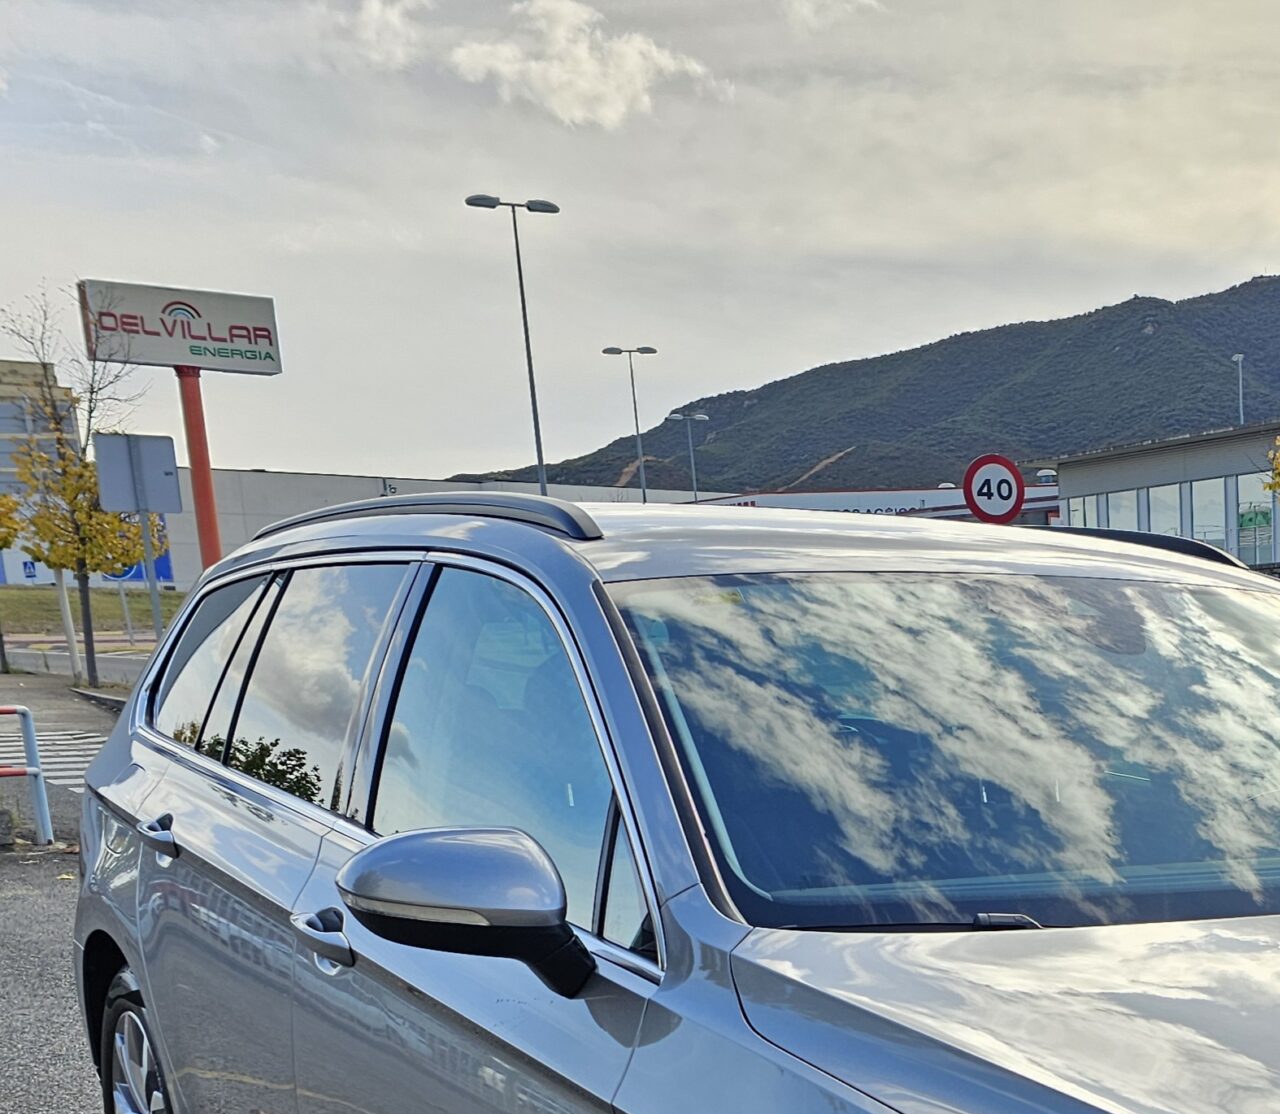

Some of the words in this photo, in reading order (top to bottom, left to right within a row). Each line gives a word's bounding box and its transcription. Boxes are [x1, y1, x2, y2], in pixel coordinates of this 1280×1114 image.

[98, 311, 273, 347] DELVILLAR
[189, 345, 275, 362] ENERGIA
[976, 478, 1013, 501] 40
